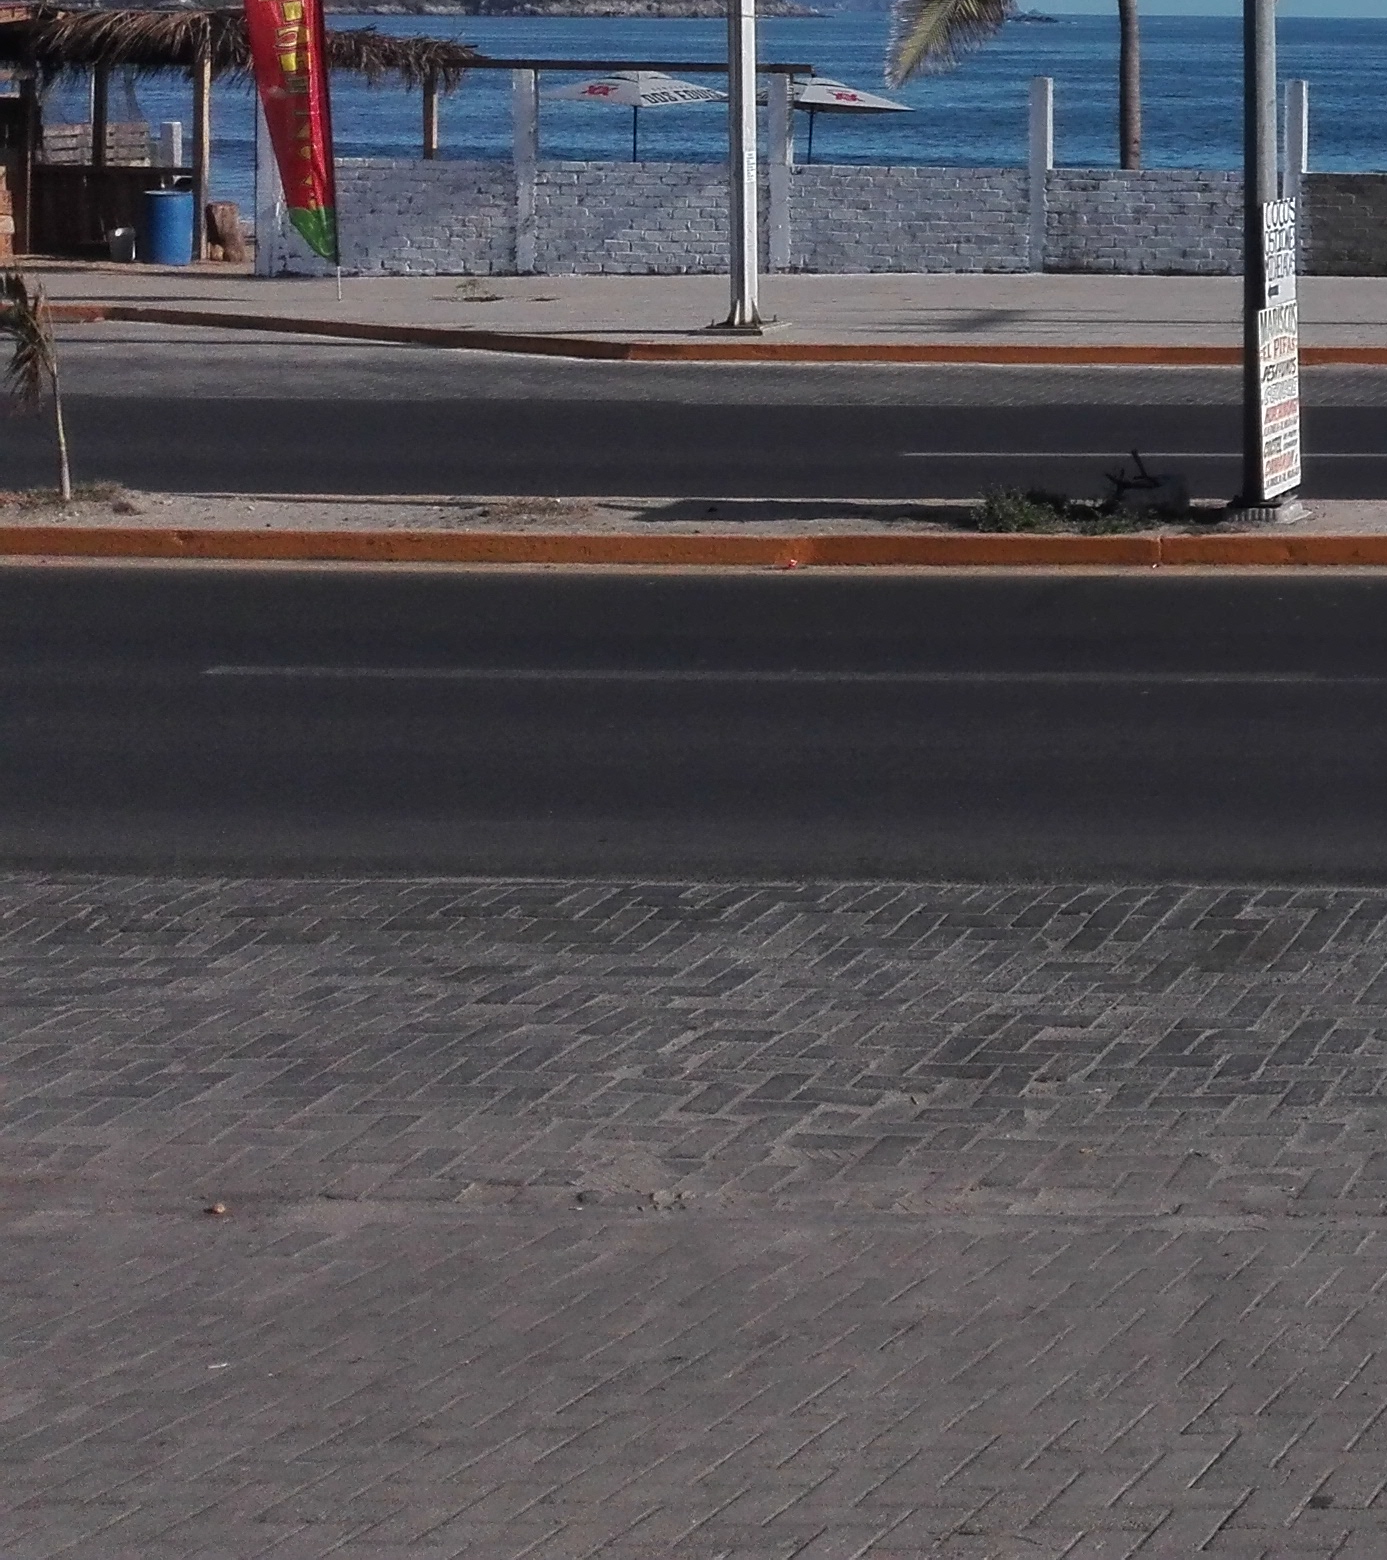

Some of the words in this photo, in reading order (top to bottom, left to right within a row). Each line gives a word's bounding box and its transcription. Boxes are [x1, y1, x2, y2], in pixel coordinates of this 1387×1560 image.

[641, 91, 678, 104] DOS
[1265, 198, 1296, 229] COCOS
[1260, 303, 1297, 343] MARISCOS
